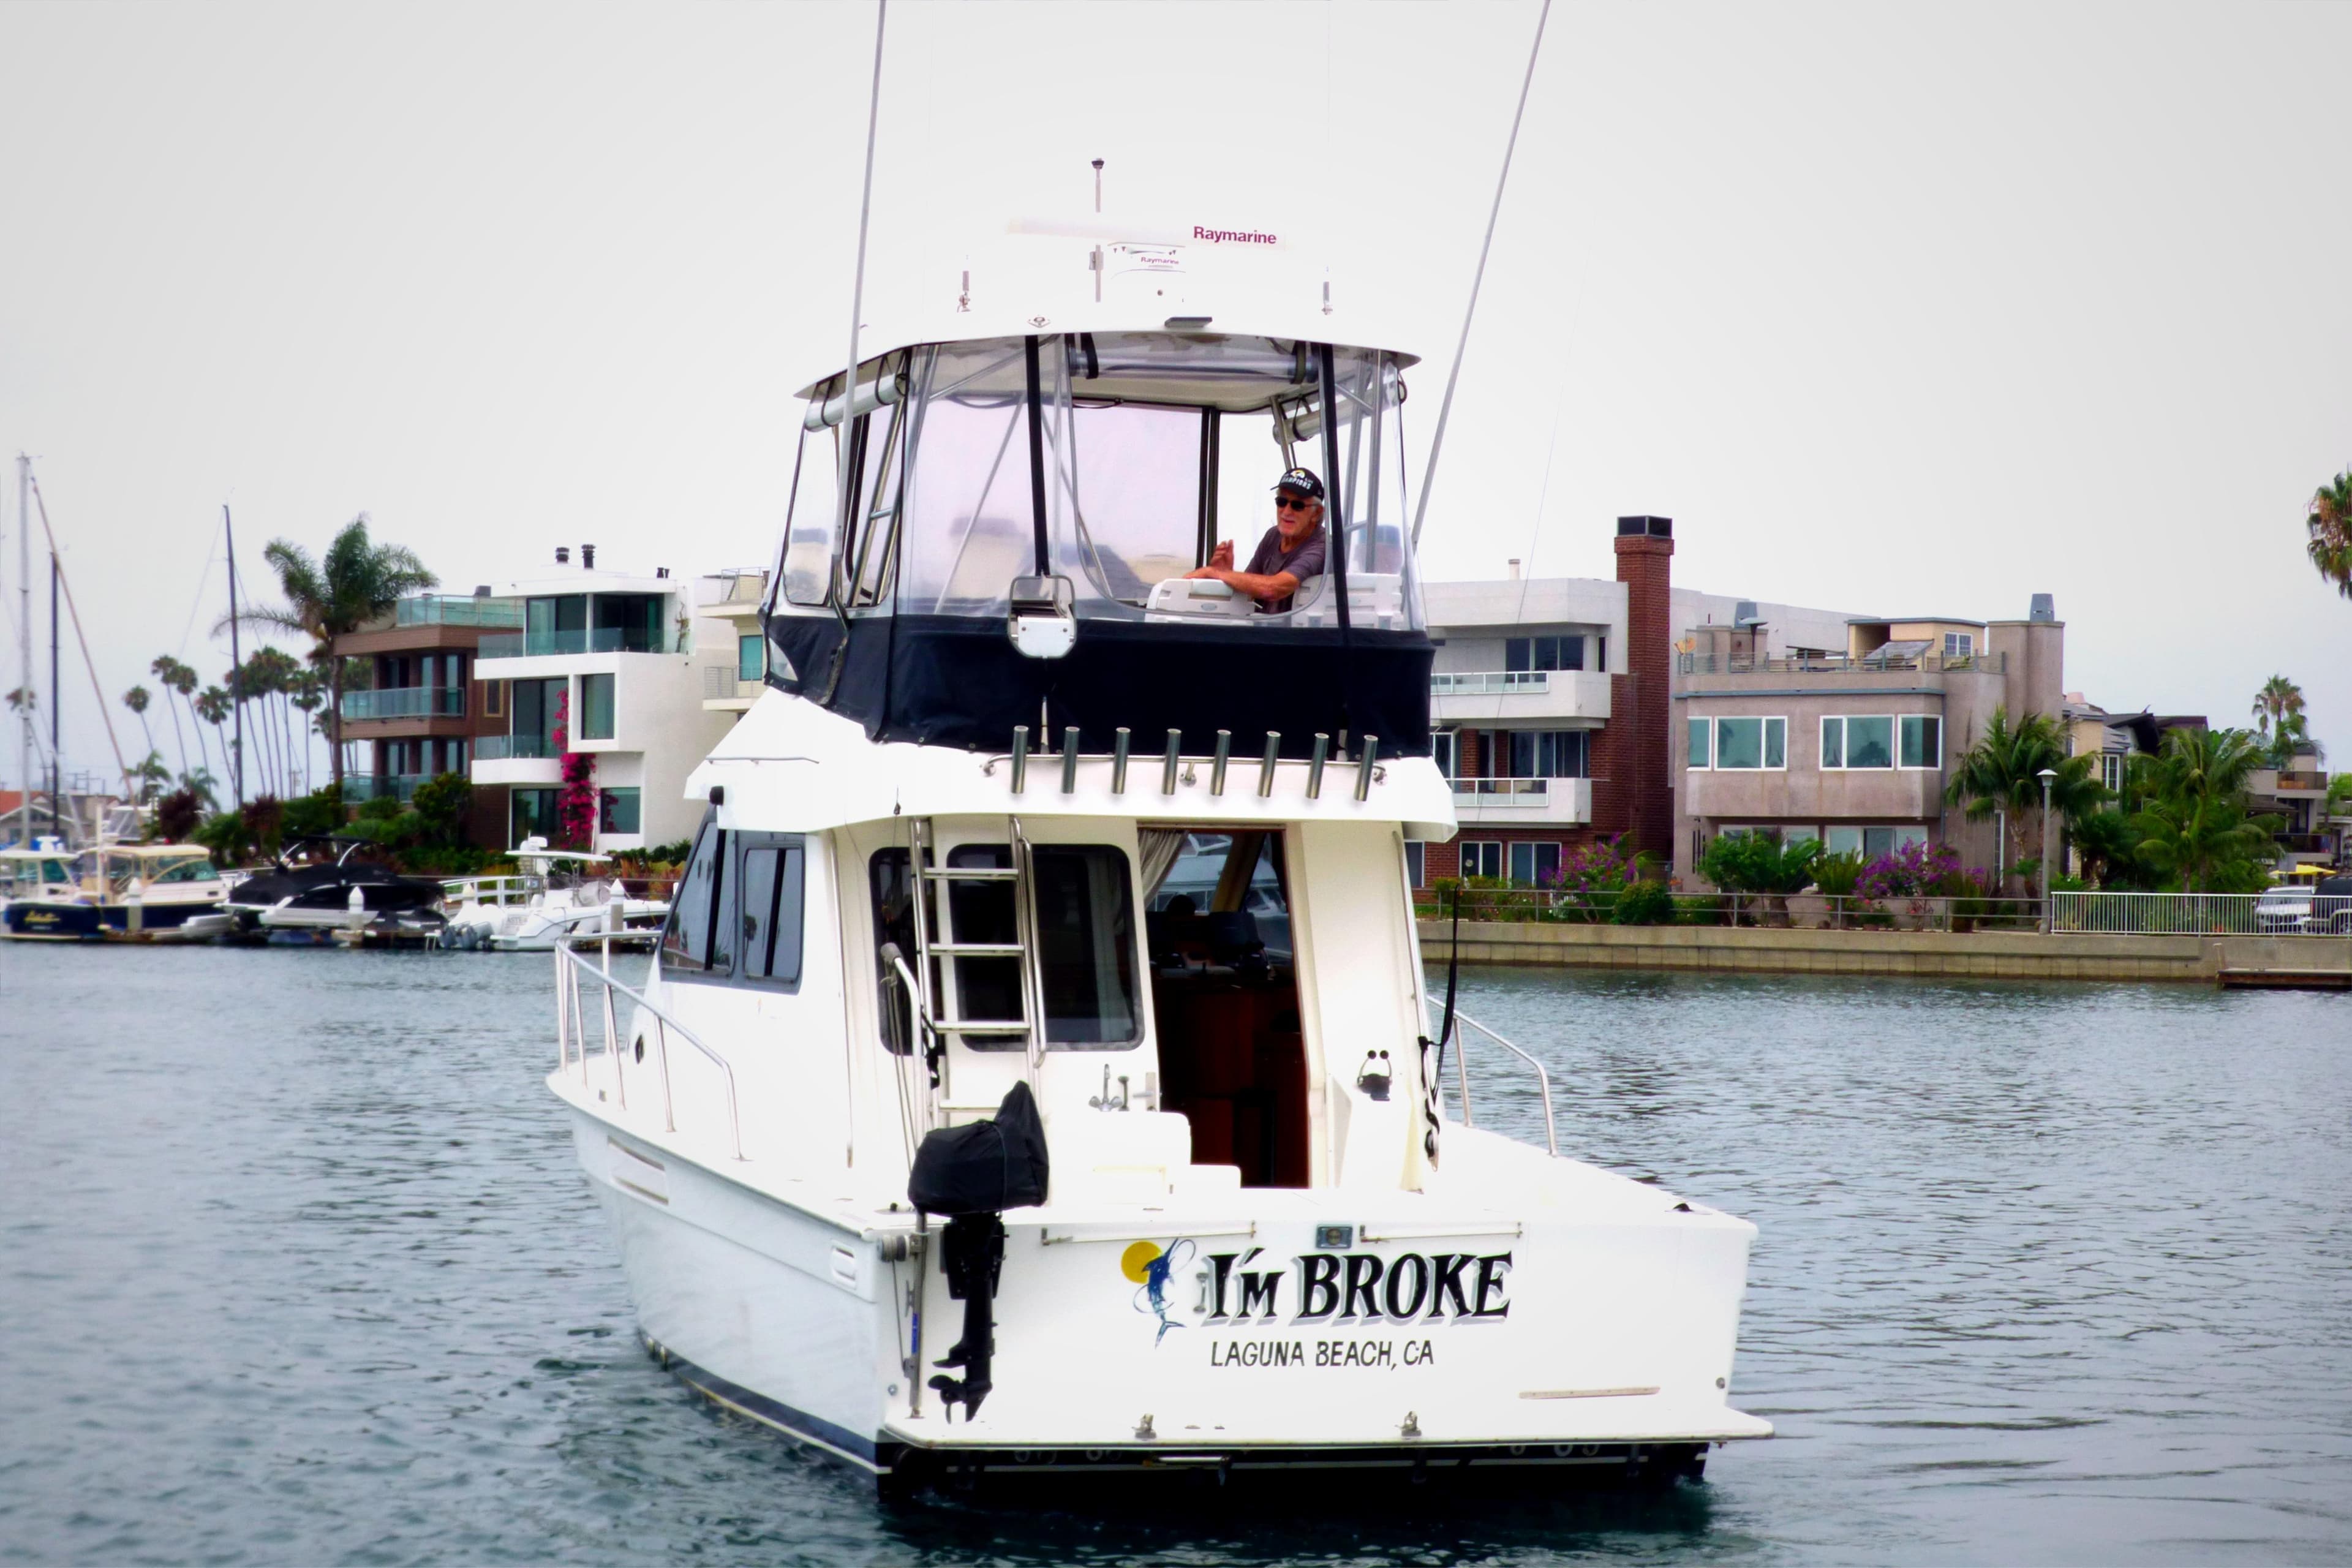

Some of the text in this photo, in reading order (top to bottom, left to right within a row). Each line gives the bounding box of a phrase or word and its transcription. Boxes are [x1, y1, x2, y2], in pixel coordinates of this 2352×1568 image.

[1194, 226, 1276, 244] Raymarine
[1289, 1250, 1513, 1326] BROKE
[1211, 1339, 1434, 1371] LAGUNA BEACH, CA
